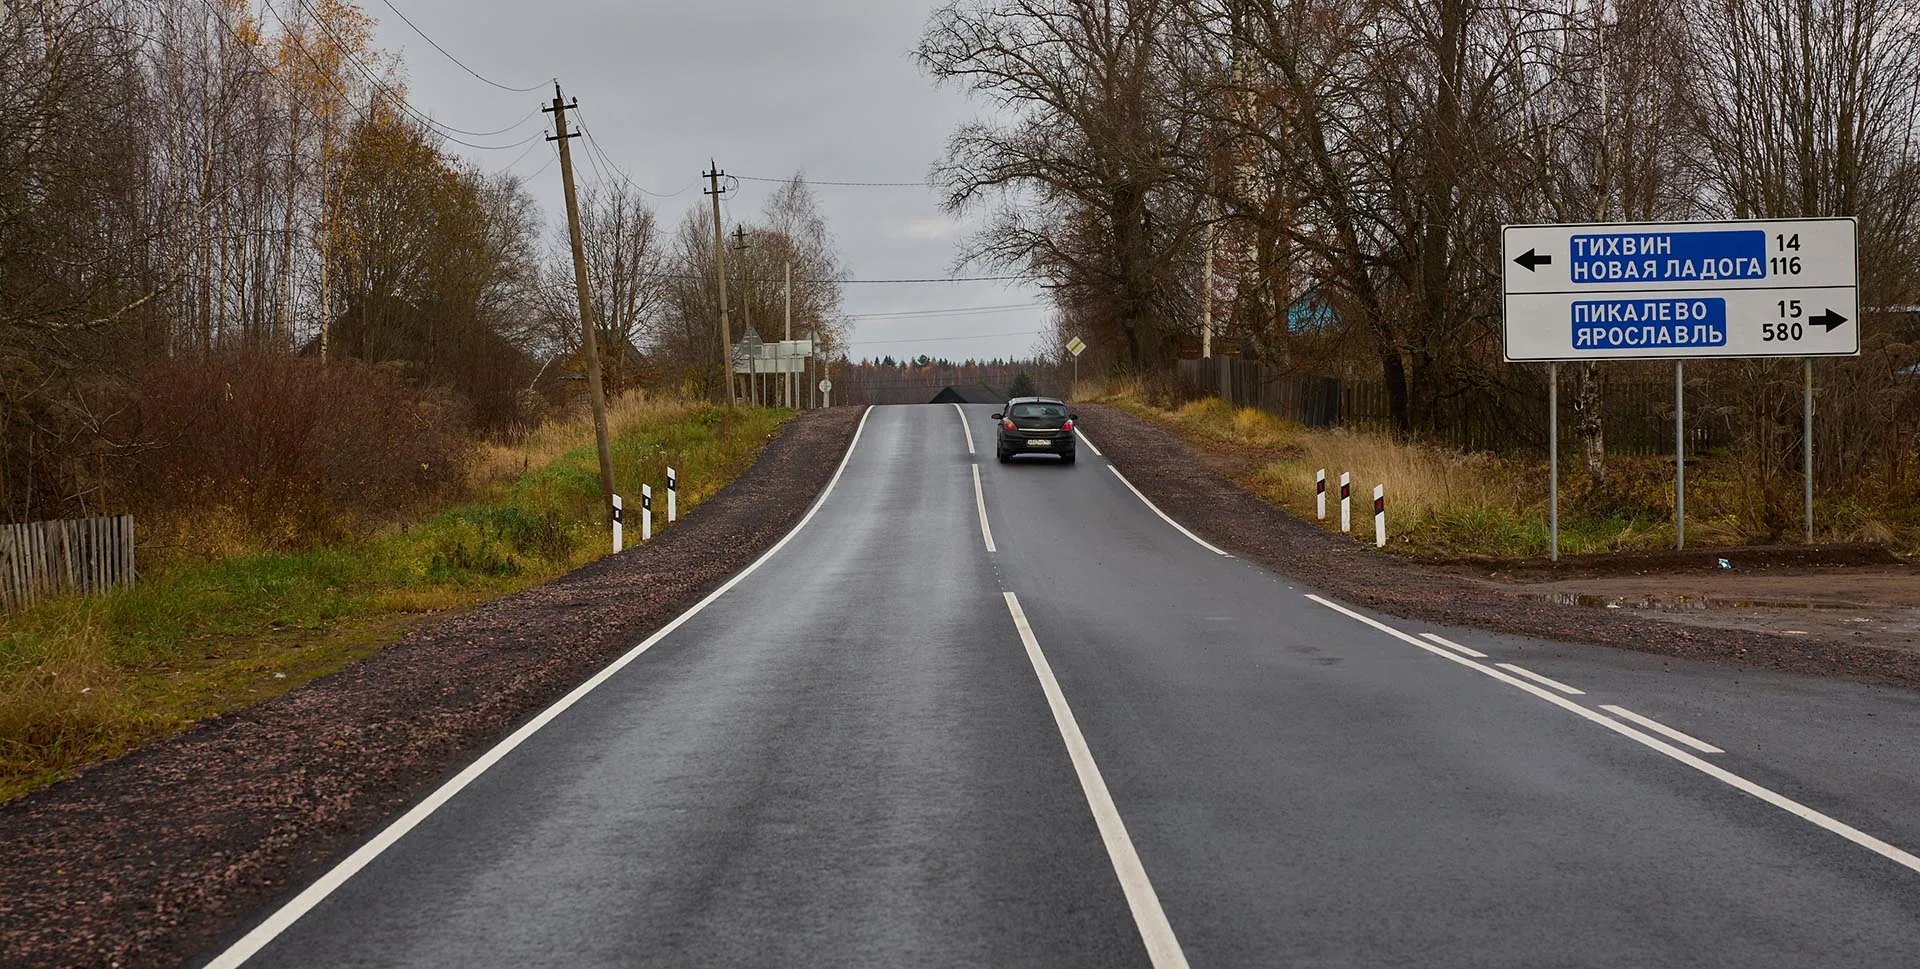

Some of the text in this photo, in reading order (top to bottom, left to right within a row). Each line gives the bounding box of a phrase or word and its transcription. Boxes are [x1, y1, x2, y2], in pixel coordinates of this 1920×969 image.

[1574, 233, 1801, 257] ТИХВИН 14
[1574, 256, 1802, 281] НОВАЯ ЛАДОГА 116
[1574, 299, 1803, 323] ПИКАЛЕВО 15
[1576, 322, 1803, 346] ЯРОСЛАВЛЬ 580
